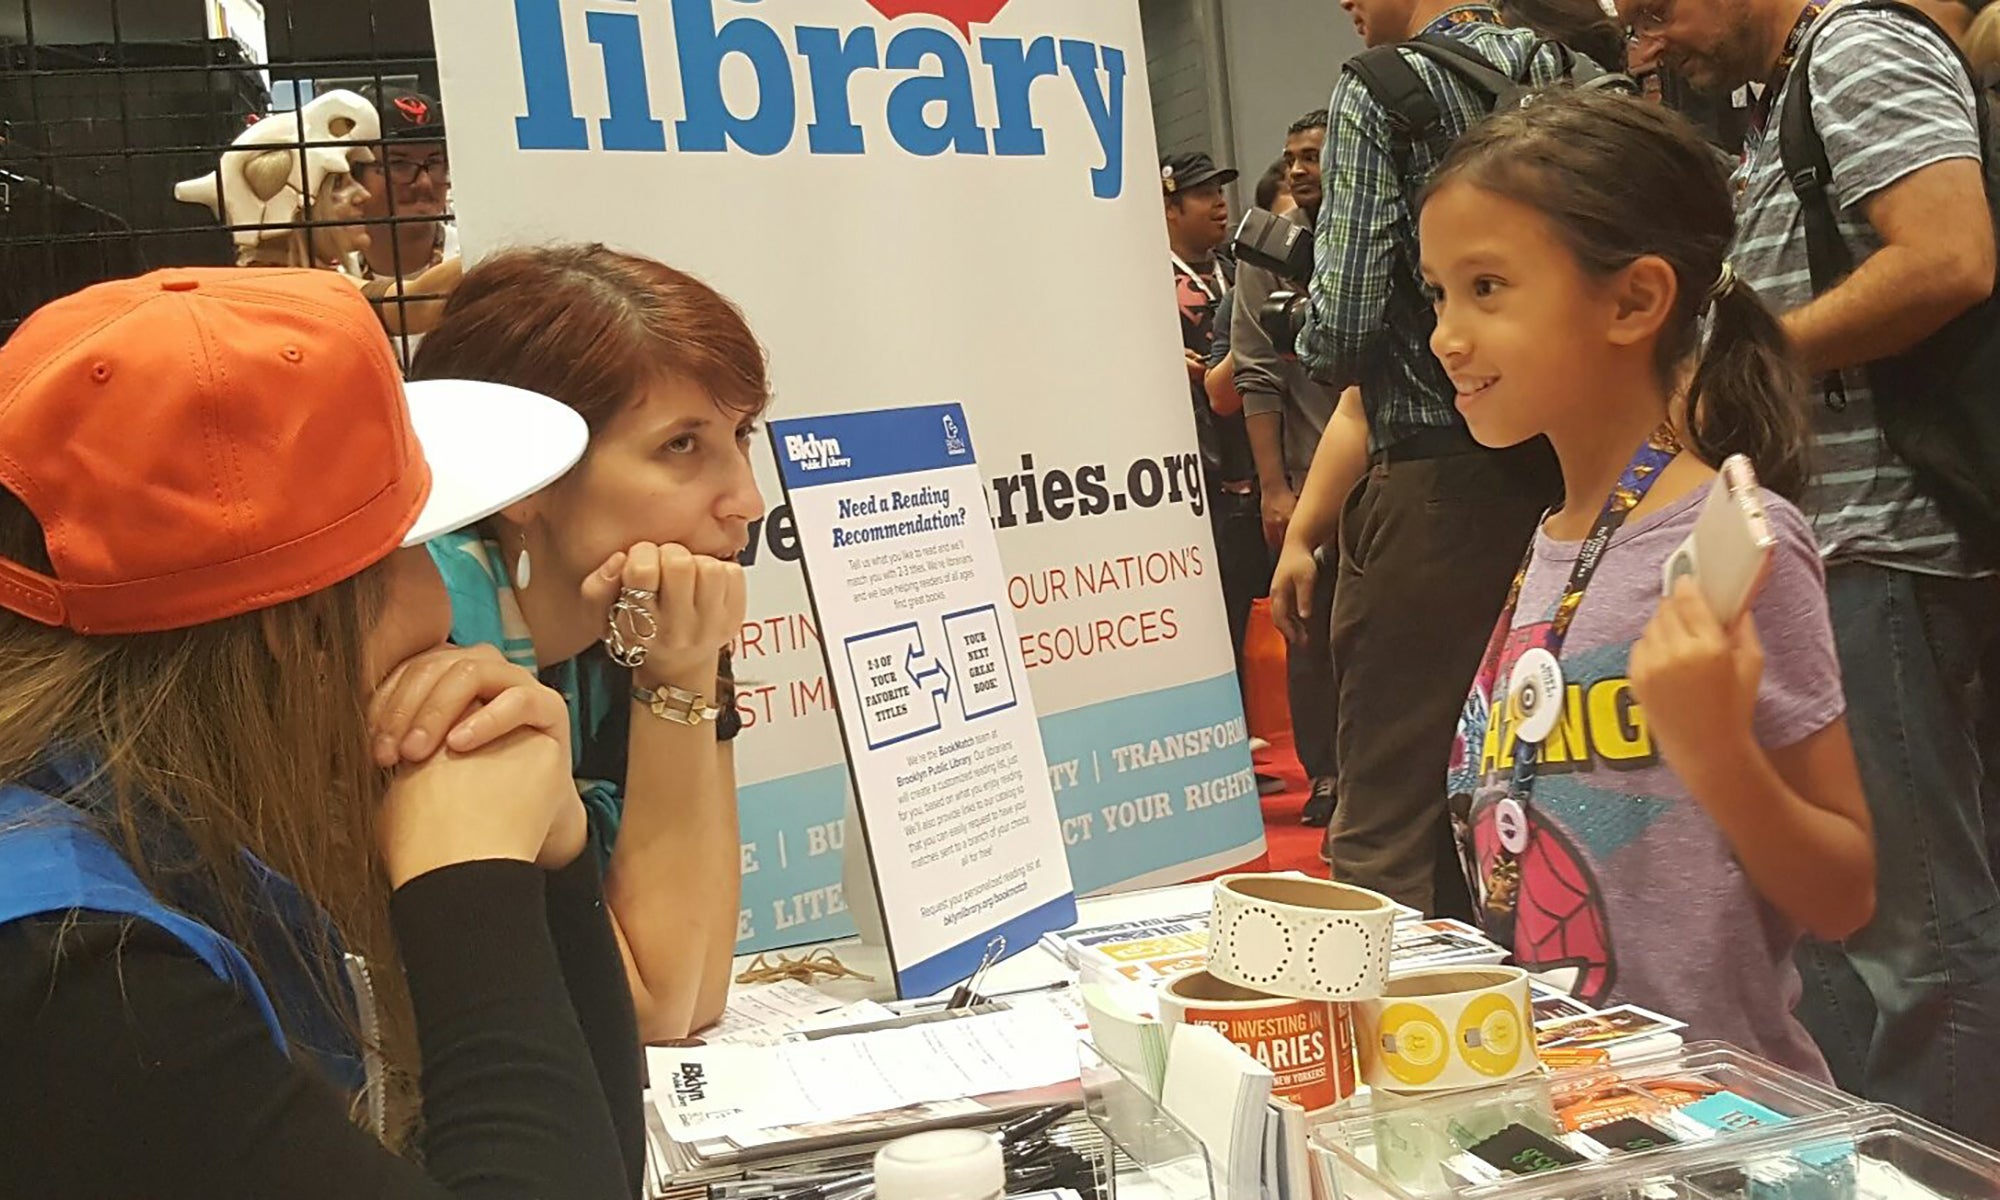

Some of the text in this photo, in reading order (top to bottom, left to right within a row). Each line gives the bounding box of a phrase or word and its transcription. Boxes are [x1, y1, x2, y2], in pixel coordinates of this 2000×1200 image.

[515, 0, 1126, 200] library
[784, 433, 841, 468] Bklyn
[801, 457, 851, 471] Public Library
[838, 486, 950, 519] Need a Reading
[982, 453, 1204, 530] ries.org
[832, 507, 966, 548] Recommendation?
[731, 546, 1203, 660] RTIN OUR NATION'S
[964, 632, 987, 646] YOUR
[735, 608, 1178, 728] ST IM ESOURCES
[880, 655, 892, 667] OF
[967, 647, 989, 661] NEXT
[870, 672, 897, 687] YOUR
[969, 662, 995, 678] GREAT
[865, 686, 910, 707] FAVORITE
[875, 704, 908, 722] TITLES
[896, 770, 928, 787] Brooklyn
[928, 762, 949, 776] Public
[1048, 759, 1080, 792] TY
[773, 882, 849, 930] LITE
[1061, 812, 1093, 846] CT
[1101, 792, 1174, 833] YOUR
[1232, 1013, 1306, 1039] INVESTING
[1309, 1010, 1323, 1029] IN
[676, 1063, 707, 1101] Bklyn
[1274, 1074, 1291, 1086] NEW
